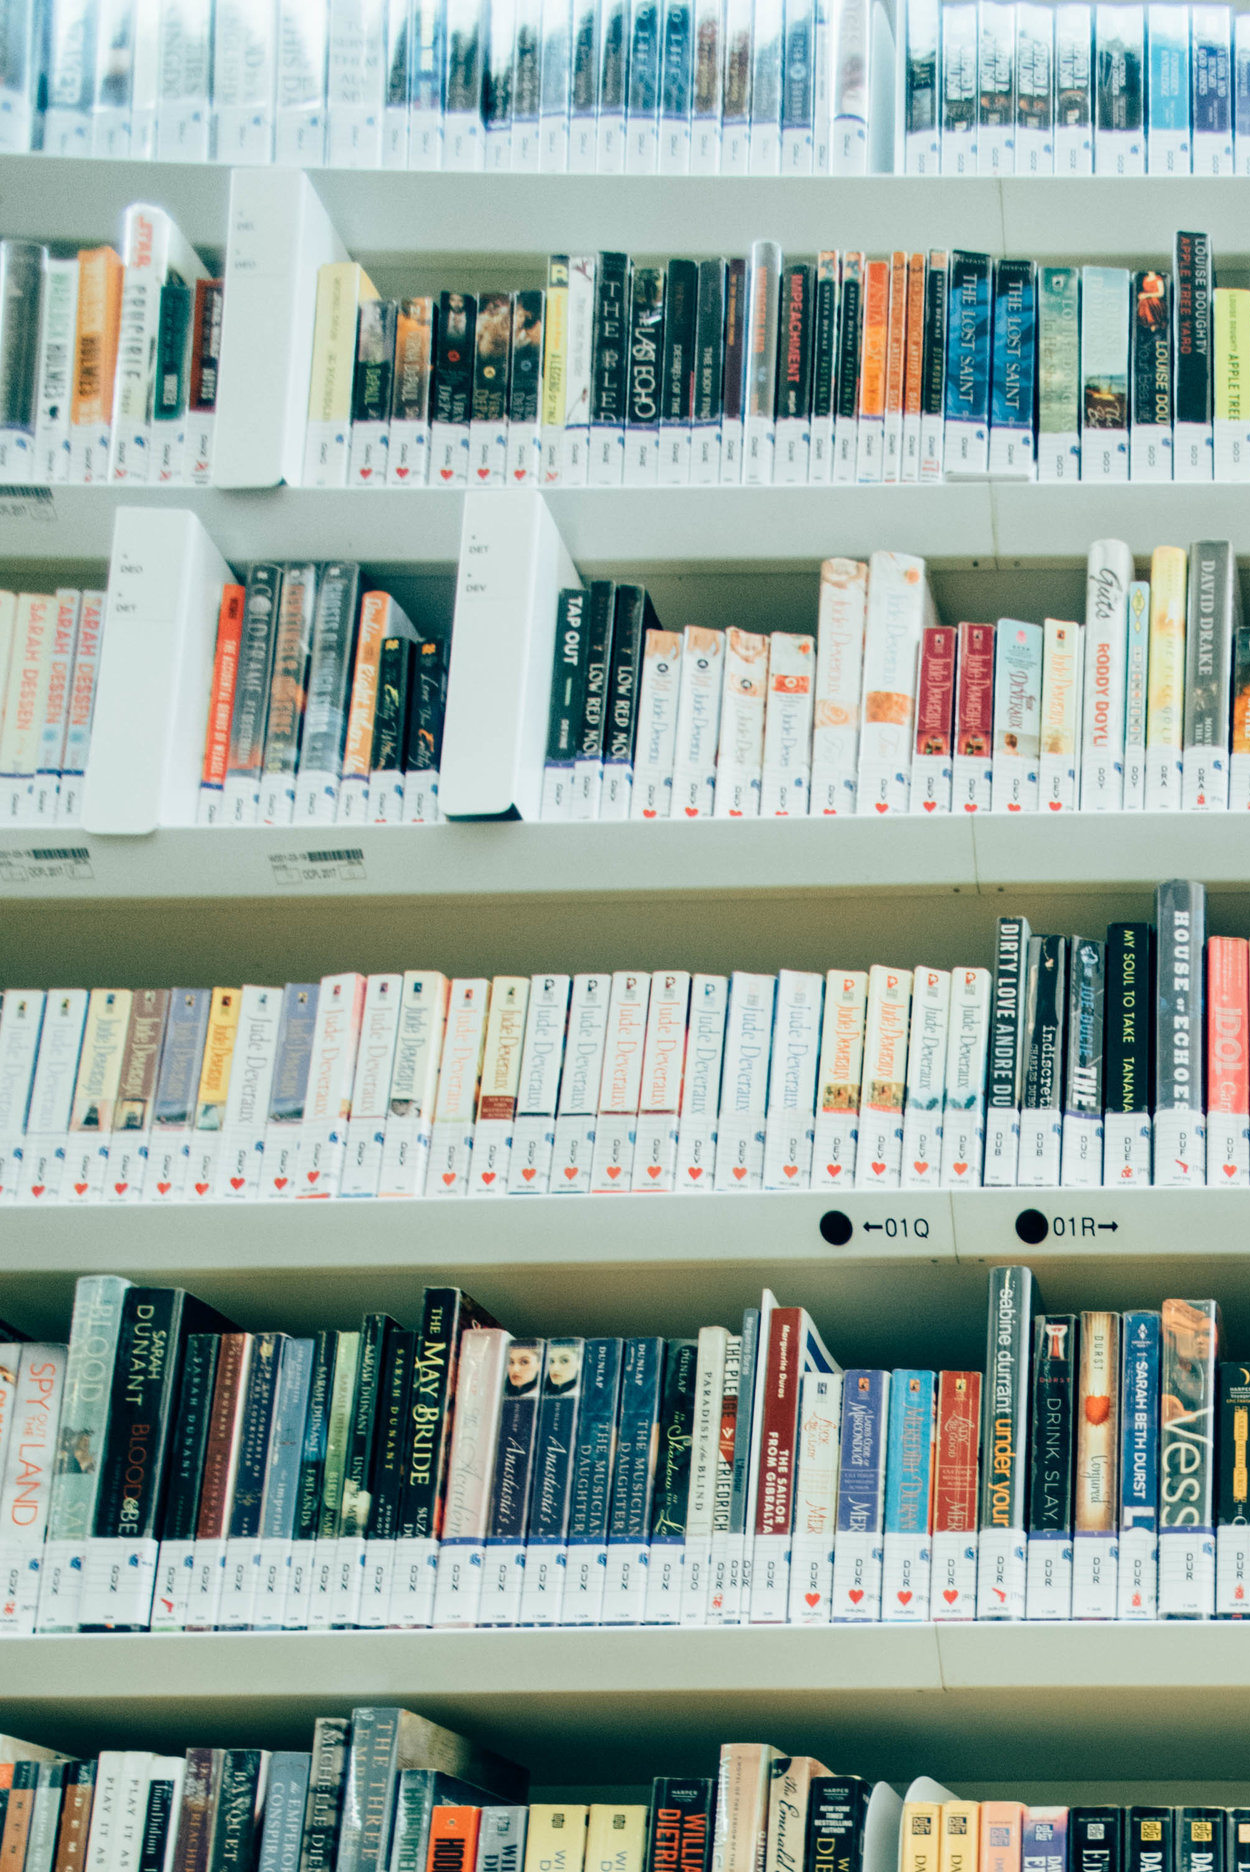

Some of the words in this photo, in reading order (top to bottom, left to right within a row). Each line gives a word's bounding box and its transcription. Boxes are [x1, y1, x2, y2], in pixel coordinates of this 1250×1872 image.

[1195, 238, 1206, 285] LOUISE
[962, 274, 977, 306] THE
[960, 311, 976, 350] LOST
[1196, 286, 1206, 355] DOUGHTY
[958, 356, 974, 404] SAINT
[1097, 568, 1117, 620] Guts
[1201, 560, 1216, 613] DAVID
[566, 598, 582, 628] TAP
[565, 630, 579, 665] OUT
[1097, 643, 1109, 692] RODDY
[1199, 617, 1213, 676] DRAKE
[998, 923, 1019, 973] DIRTY
[1124, 930, 1134, 948] MY
[1174, 912, 1190, 991] HOUSE
[1124, 951, 1135, 985] SOUL
[996, 979, 1017, 1019] LOVE
[1124, 991, 1134, 1007] TO
[1124, 1010, 1135, 1043] TAKE
[885, 1218, 929, 1238] 01Q
[1053, 1217, 1095, 1236] 01R
[430, 1307, 443, 1334] THE
[999, 1289, 1013, 1344] sabine
[127, 1305, 154, 1406] DUNANT
[150, 1330, 166, 1380] SARAH
[416, 1342, 445, 1396] MAY
[30, 1363, 55, 1412] SPY
[996, 1348, 1013, 1414] durrant
[1135, 1362, 1148, 1407] SARAH
[410, 1403, 439, 1485] BRIDE
[993, 1419, 1013, 1477] under
[1134, 1412, 1146, 1445] BETH
[778, 1450, 789, 1472] THE
[1133, 1448, 1146, 1499] DURST
[12, 1445, 41, 1526] LAND
[775, 1476, 787, 1523] SAILOR
